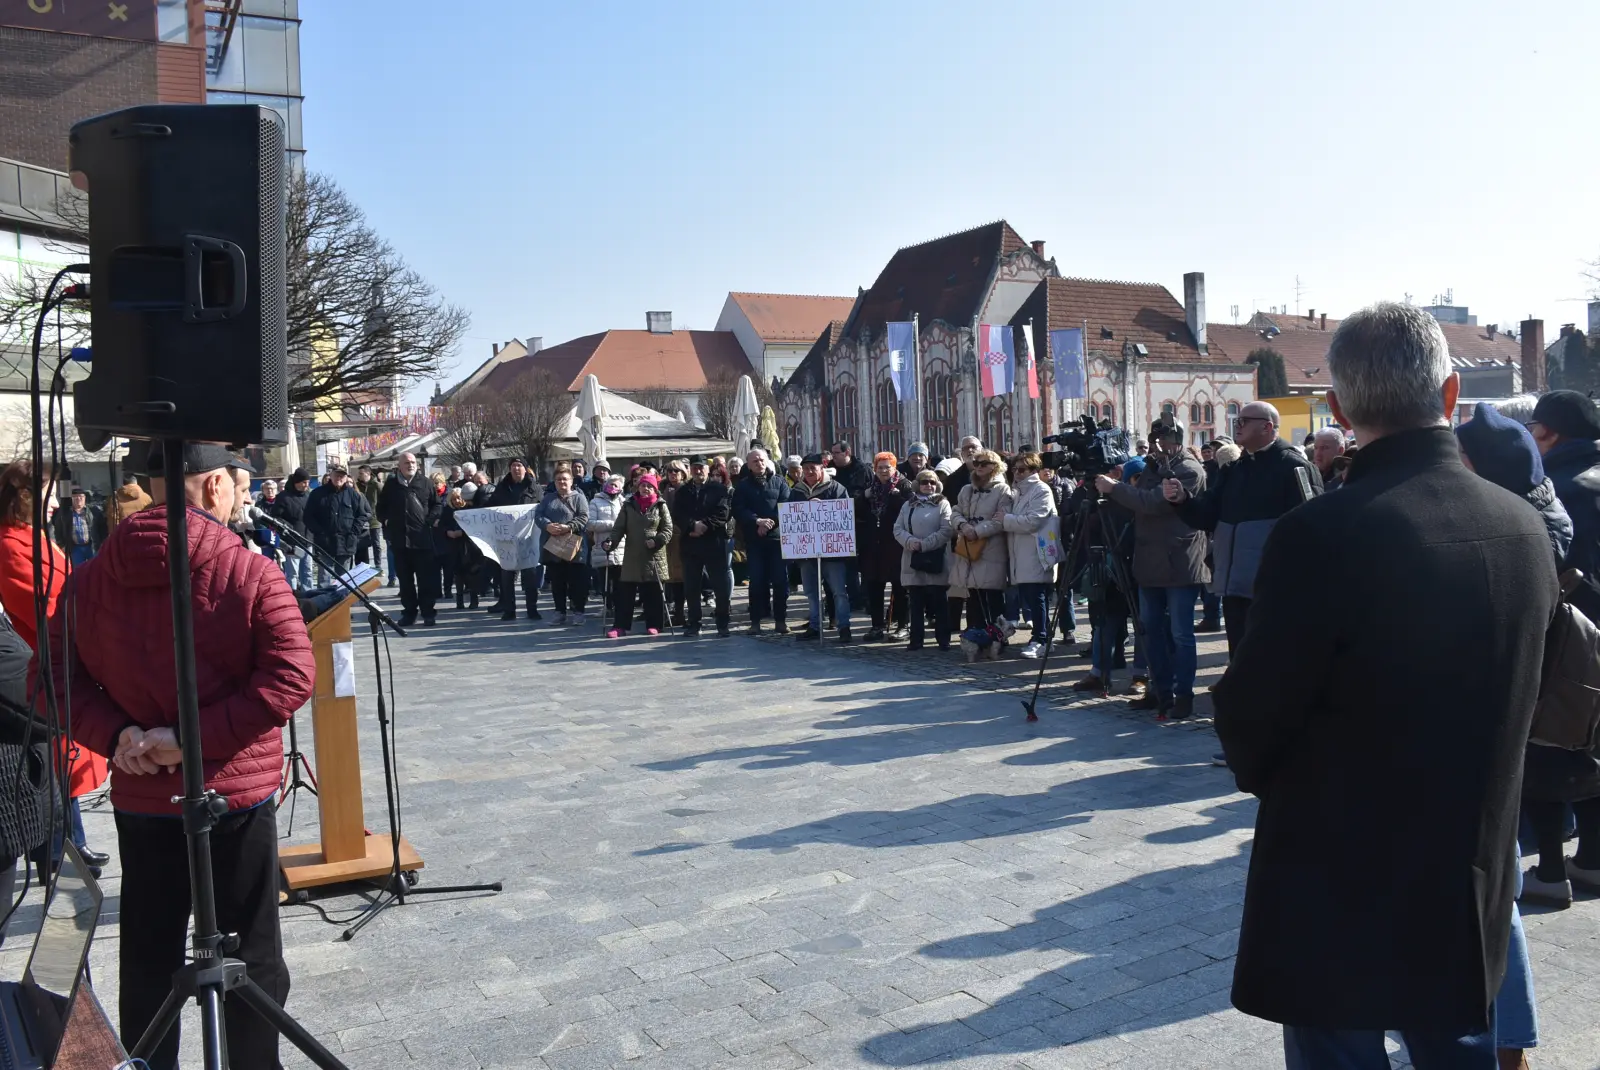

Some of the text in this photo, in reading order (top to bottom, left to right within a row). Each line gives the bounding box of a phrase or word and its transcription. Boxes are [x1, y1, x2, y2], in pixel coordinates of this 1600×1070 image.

[608, 413, 651, 422] triglav
[789, 502, 804, 513] HDZ
[824, 511, 837, 521] STE
[840, 510, 852, 520] NAS
[495, 524, 509, 535] NE
[781, 535, 792, 544] BEZ
[820, 532, 852, 543] KIRURGA
[793, 544, 807, 554] NAS
[822, 541, 854, 553] UBIJATE
